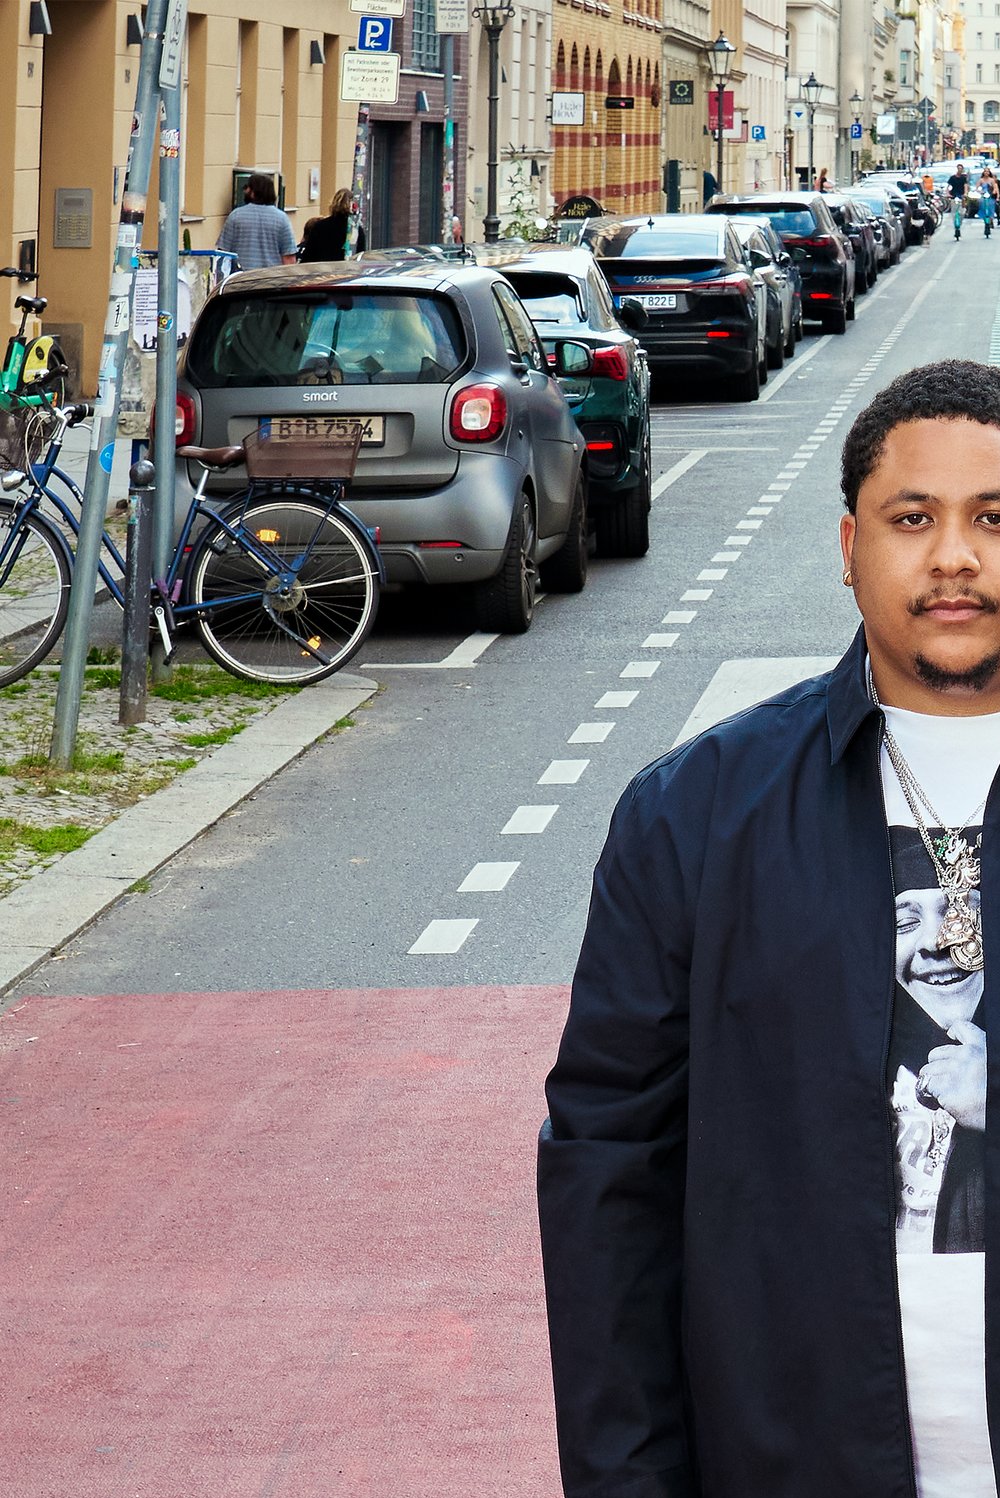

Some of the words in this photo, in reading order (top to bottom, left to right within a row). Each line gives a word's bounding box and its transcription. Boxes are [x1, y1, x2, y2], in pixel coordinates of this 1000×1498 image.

[365, 20, 384, 47] P
[753, 127, 762, 138] P
[852, 126, 860, 137] P
[303, 391, 338, 402] smart
